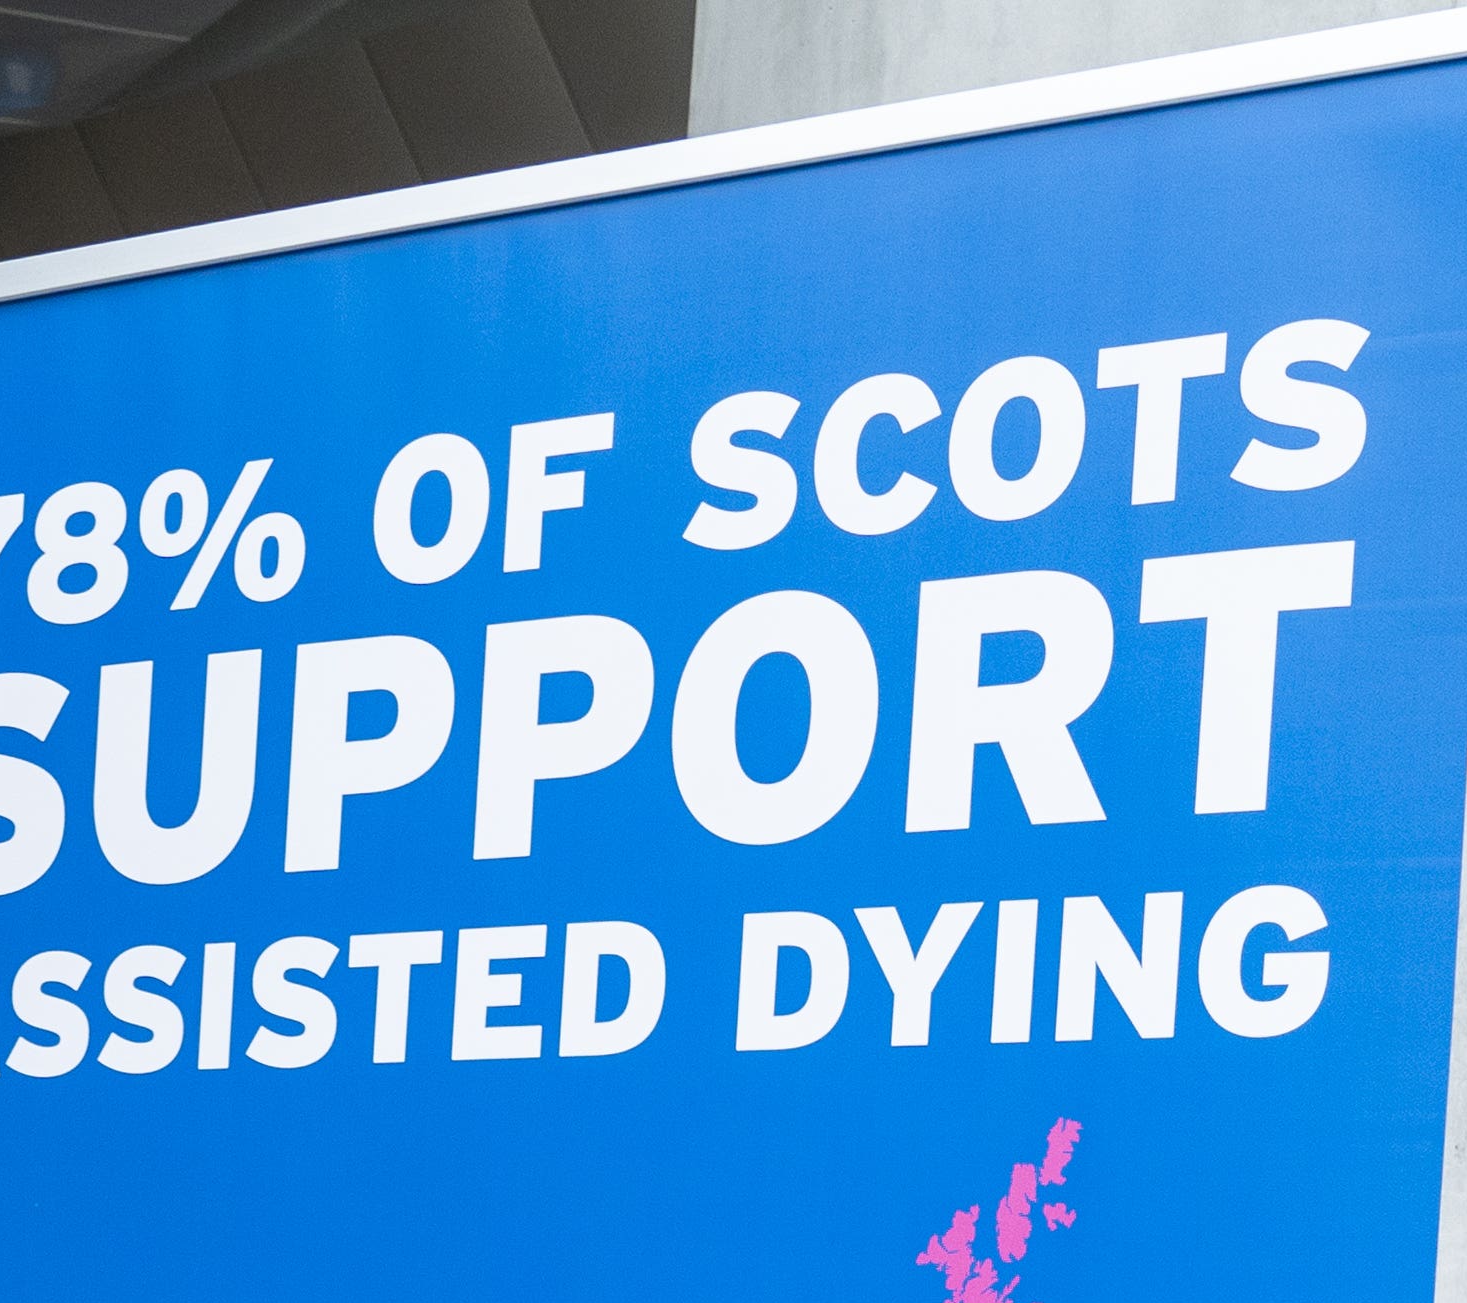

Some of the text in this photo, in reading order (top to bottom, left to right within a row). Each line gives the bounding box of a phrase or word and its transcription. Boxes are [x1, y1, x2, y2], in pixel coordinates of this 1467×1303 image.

[374, 413, 614, 584] OF
[683, 319, 1370, 550] SCOTS
[736, 885, 1329, 1051] DYING
